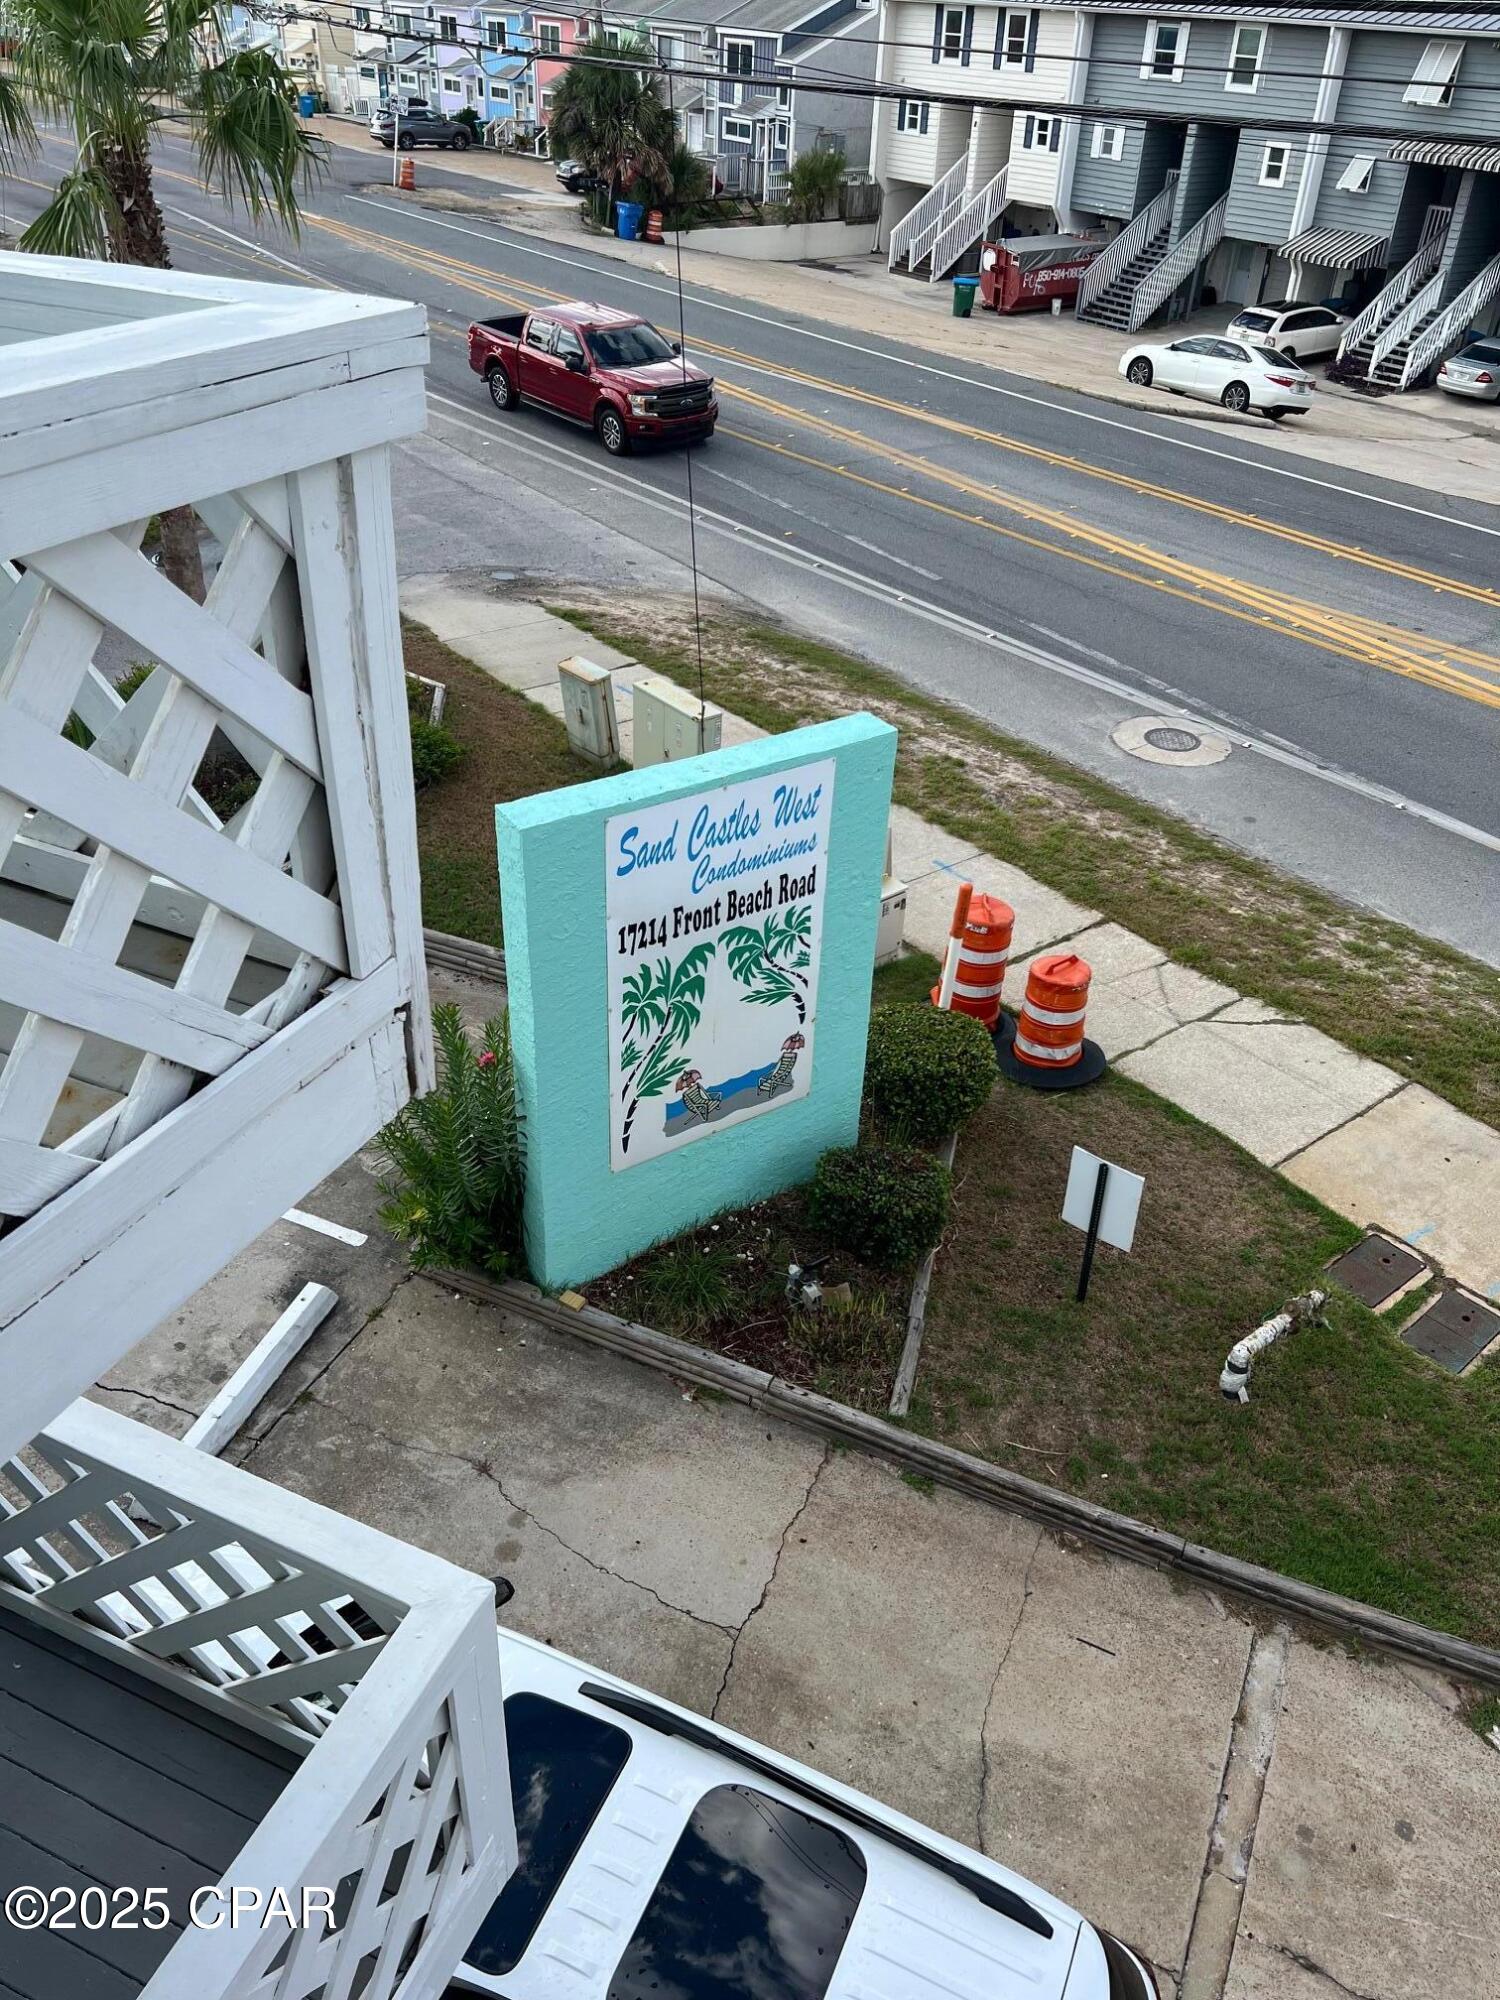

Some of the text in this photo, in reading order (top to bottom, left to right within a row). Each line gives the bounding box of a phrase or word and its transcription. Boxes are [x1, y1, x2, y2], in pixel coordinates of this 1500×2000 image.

[616, 784, 823, 877] Sand Castles West
[691, 832, 818, 895] Condominiums
[618, 865, 817, 956] 17214 Front Beach Road
